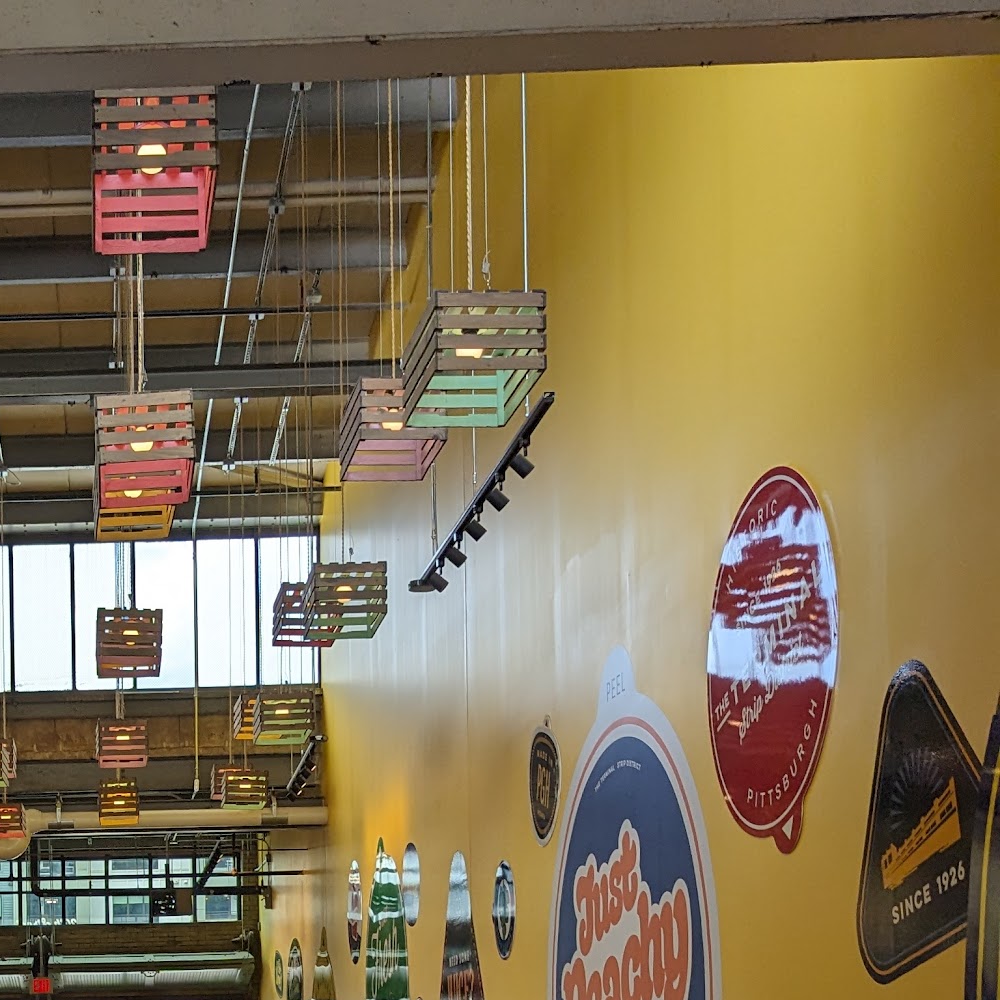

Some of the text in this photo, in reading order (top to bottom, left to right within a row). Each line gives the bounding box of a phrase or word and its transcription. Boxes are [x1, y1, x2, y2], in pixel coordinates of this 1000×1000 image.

[714, 559, 822, 721] THE TEMINAL
[606, 671, 625, 702] PEEL
[738, 694, 764, 745] Strip
[747, 698, 818, 808] PITTSBURGH
[576, 831, 638, 957] Just
[891, 860, 966, 925] SINCE 1926
